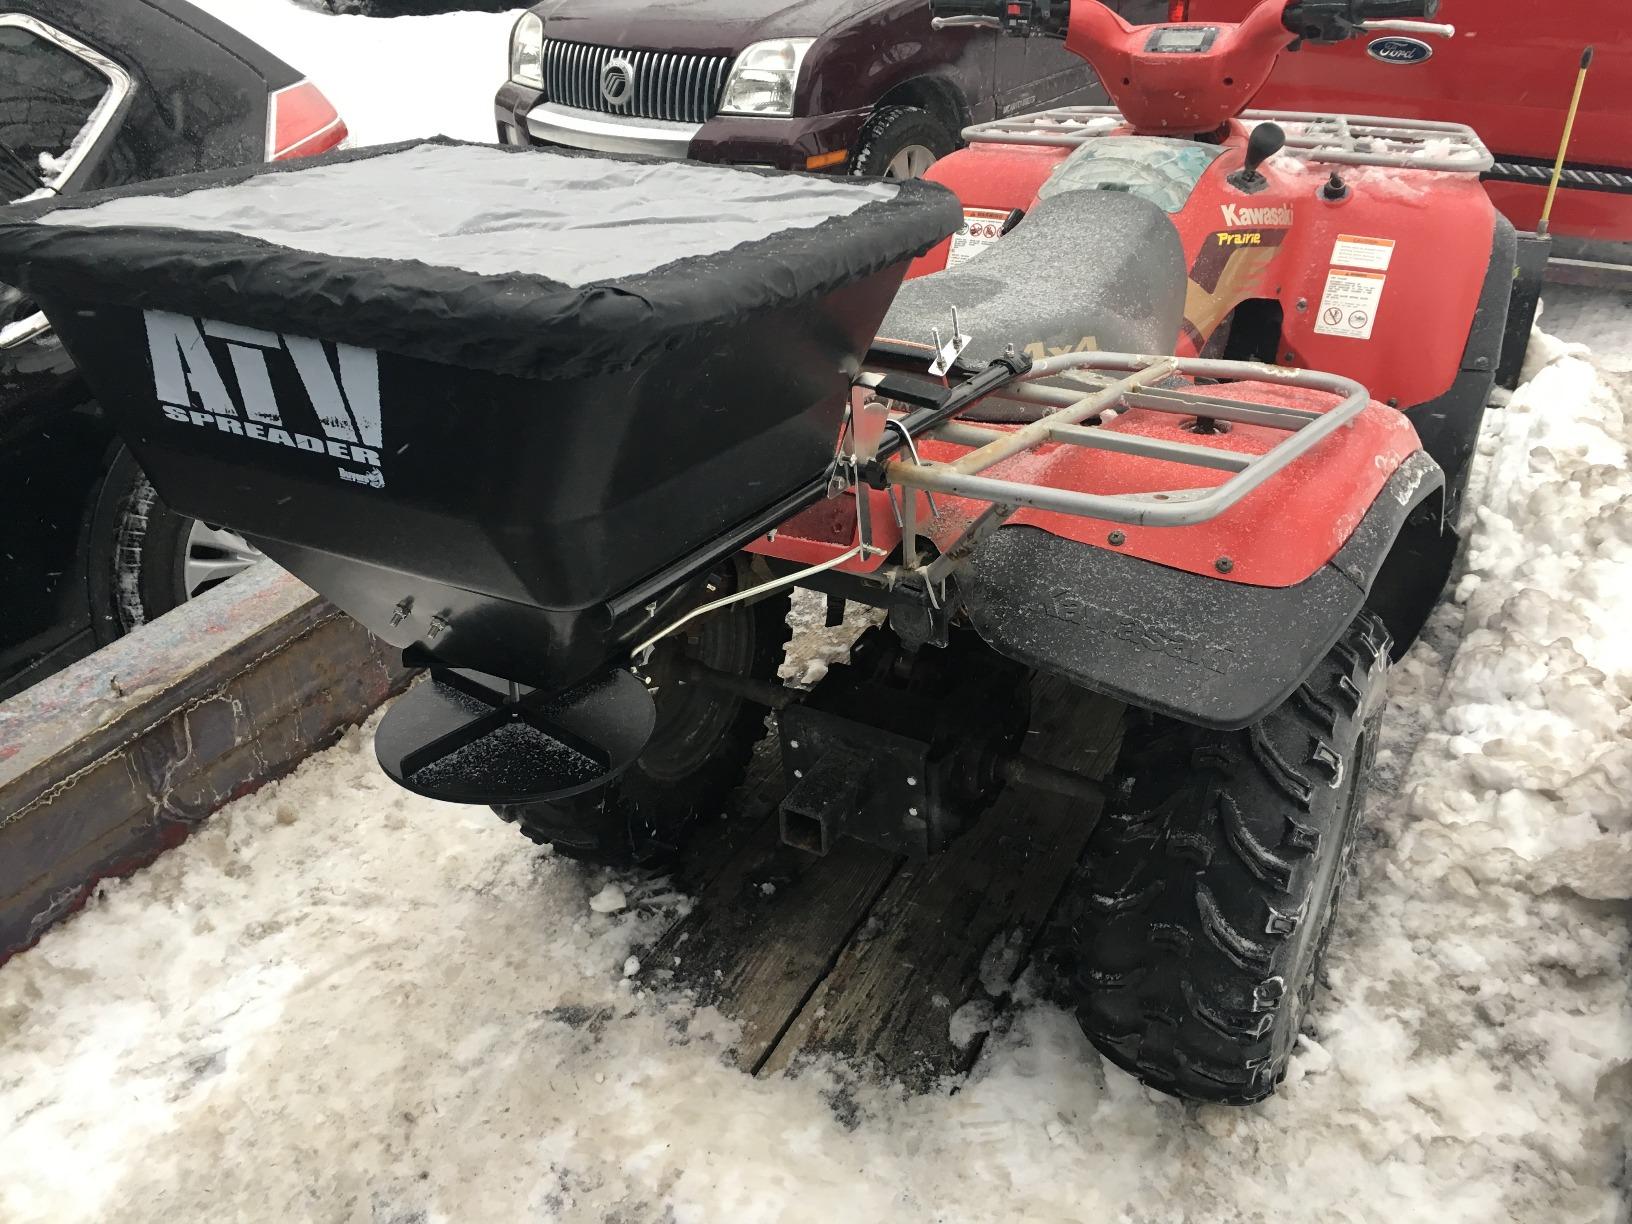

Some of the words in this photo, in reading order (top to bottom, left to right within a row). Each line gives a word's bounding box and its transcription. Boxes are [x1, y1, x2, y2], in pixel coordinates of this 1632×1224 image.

[1380, 41, 1417, 59] Ford
[1221, 203, 1294, 226] Kawasaki
[1216, 233, 1262, 246] Prairie
[143, 309, 383, 450] ATV
[162, 404, 382, 467] SPREADER
